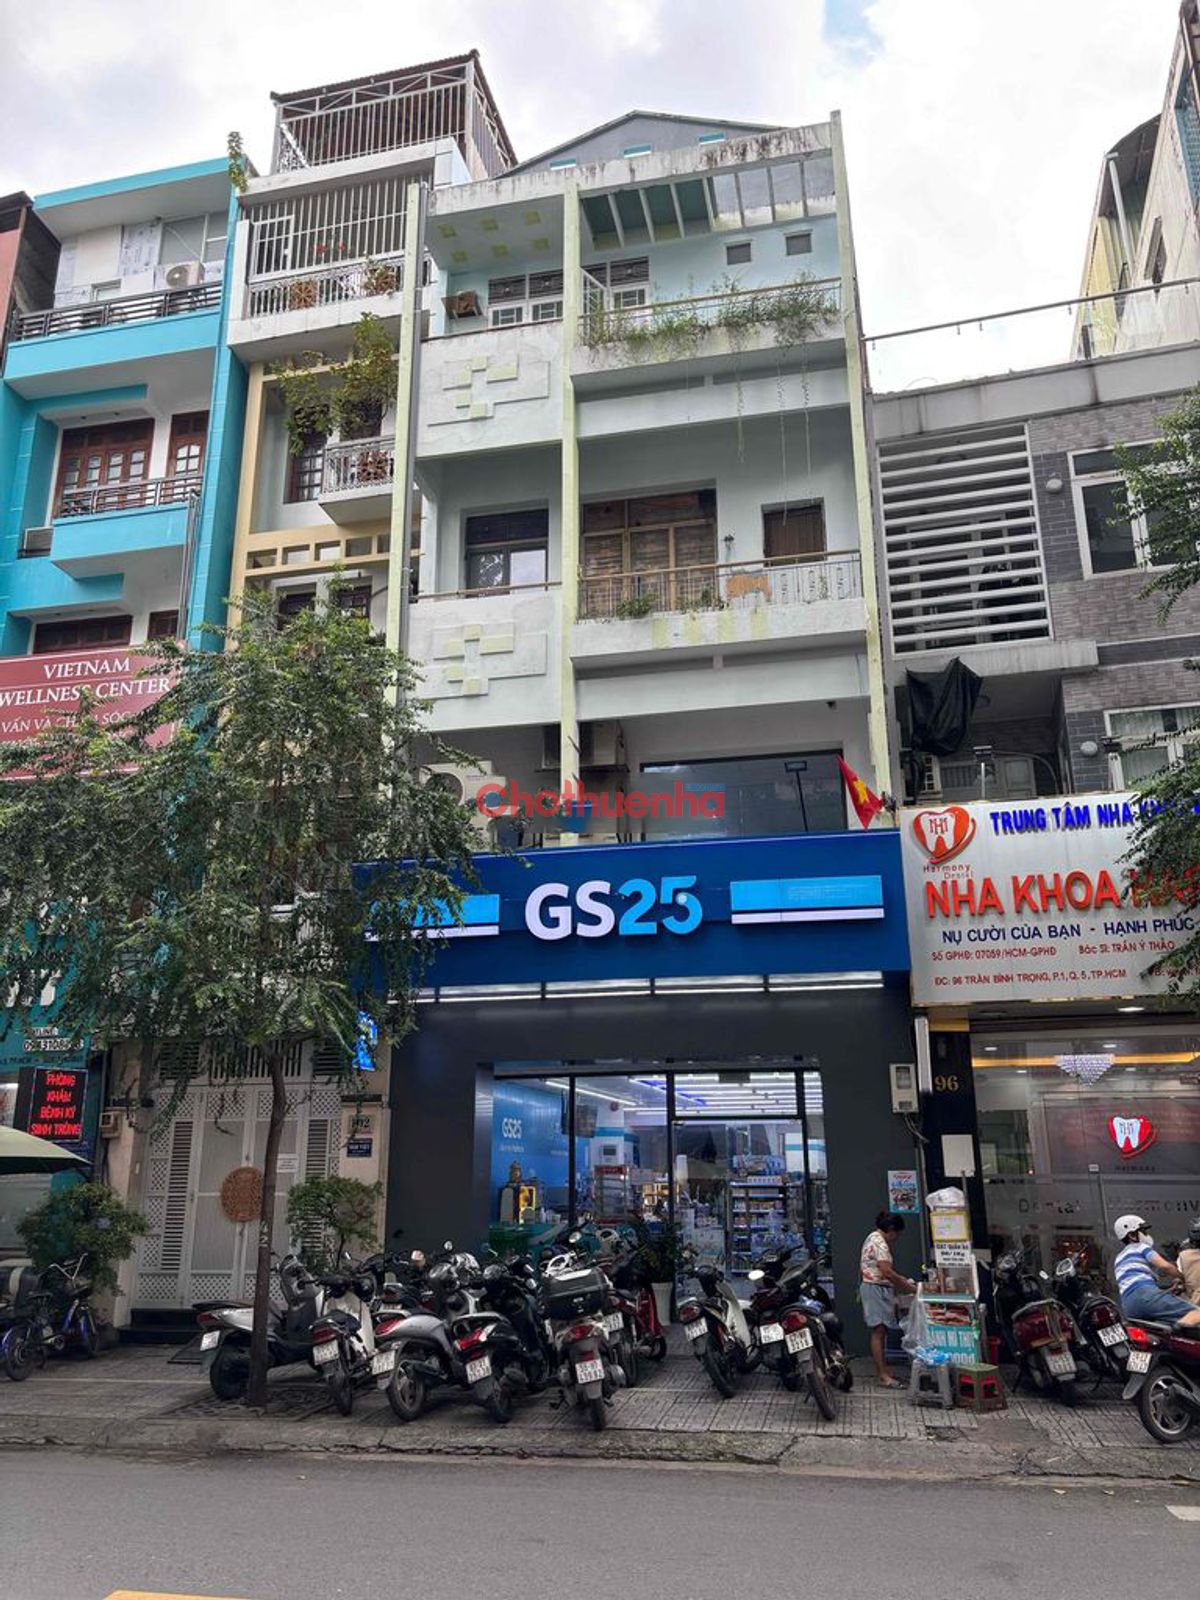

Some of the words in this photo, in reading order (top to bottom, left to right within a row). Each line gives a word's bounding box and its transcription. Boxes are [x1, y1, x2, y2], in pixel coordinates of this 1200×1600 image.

[44, 657, 130, 679] VIETNAM
[96, 678, 170, 699] CENTER
[990, 808, 1047, 835] TRUNG
[1051, 801, 1092, 830] TÂM
[1097, 802, 1134, 828] NHA
[525, 876, 702, 940] GS25
[925, 877, 1005, 918] NHA
[1012, 869, 1122, 914] KHOA
[942, 930, 962, 945] NỤ
[967, 924, 1006, 942] CƯỜI
[1011, 923, 1042, 940] CỦA
[1048, 924, 1081, 940] BẠN
[1104, 920, 1147, 937] HẠNH
[1152, 915, 1195, 932] PHÚC
[935, 1075, 959, 1091] 96
